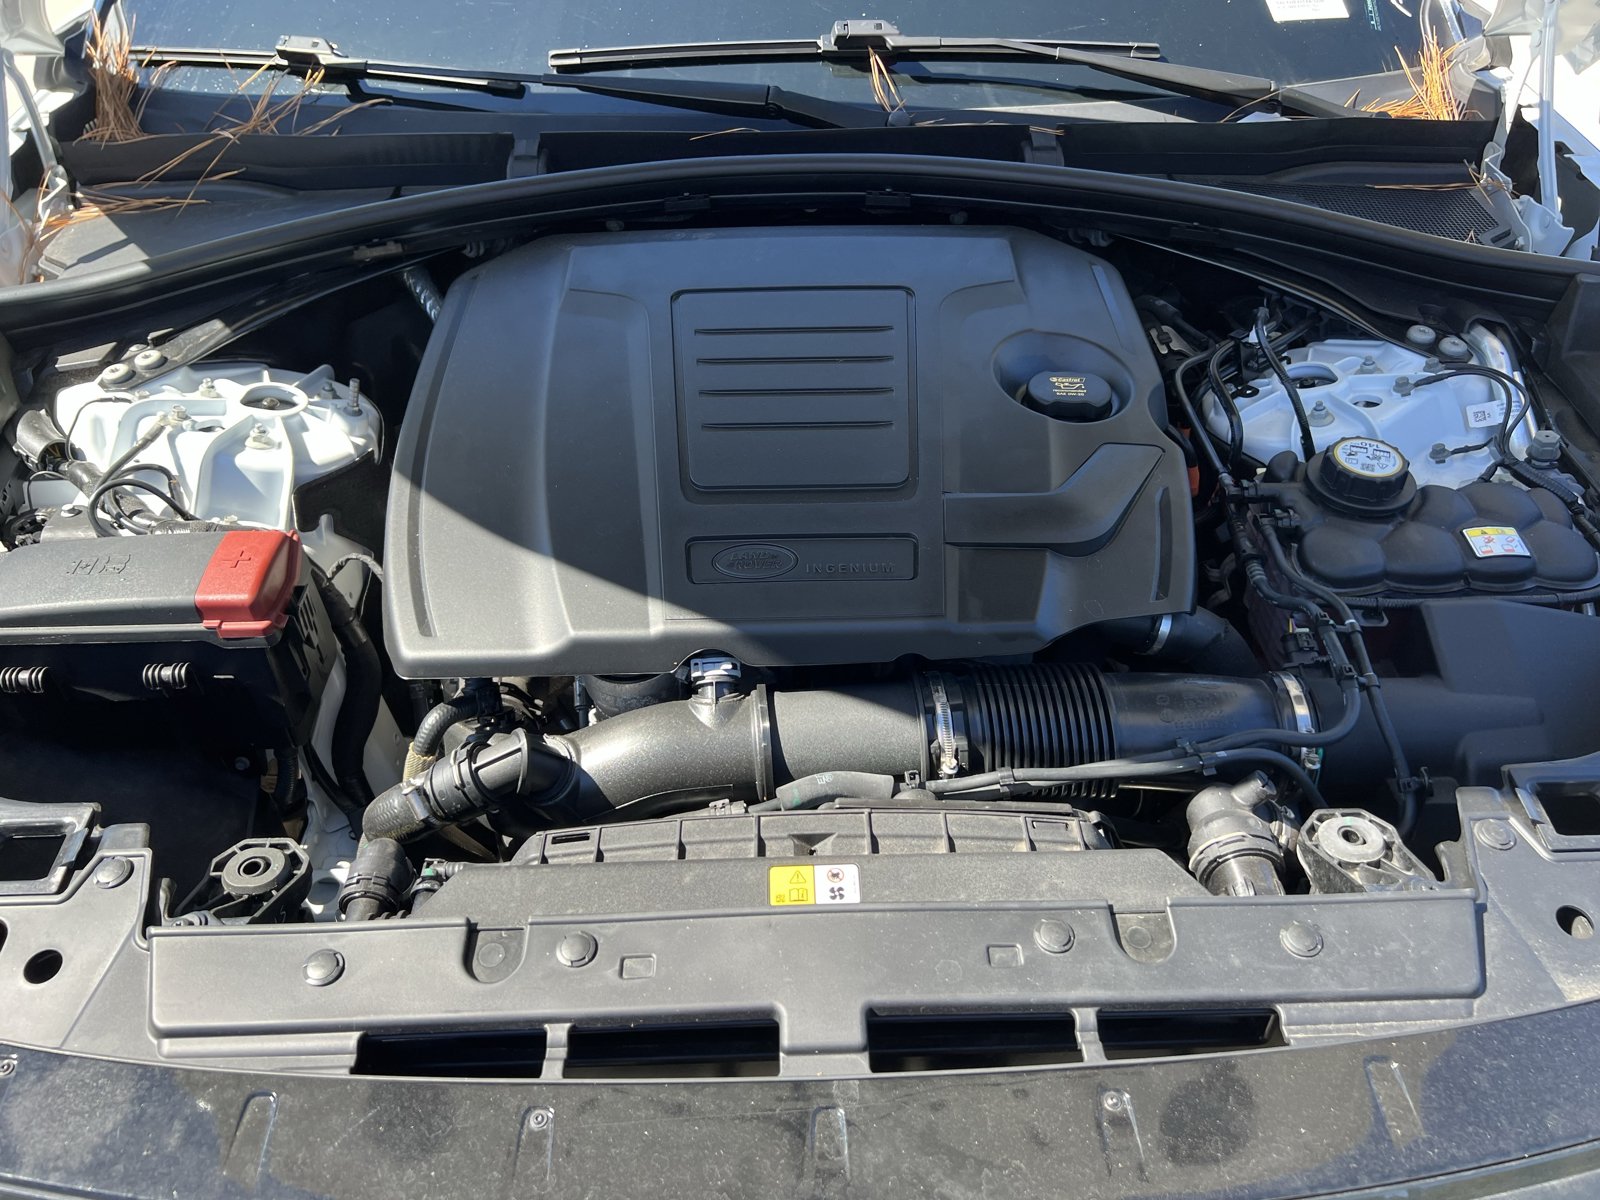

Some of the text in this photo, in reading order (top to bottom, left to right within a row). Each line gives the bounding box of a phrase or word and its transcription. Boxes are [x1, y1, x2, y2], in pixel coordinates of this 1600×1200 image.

[730, 552, 769, 561] LAND
[735, 560, 783, 569] ROVER
[805, 561, 896, 573] INGENIUM
